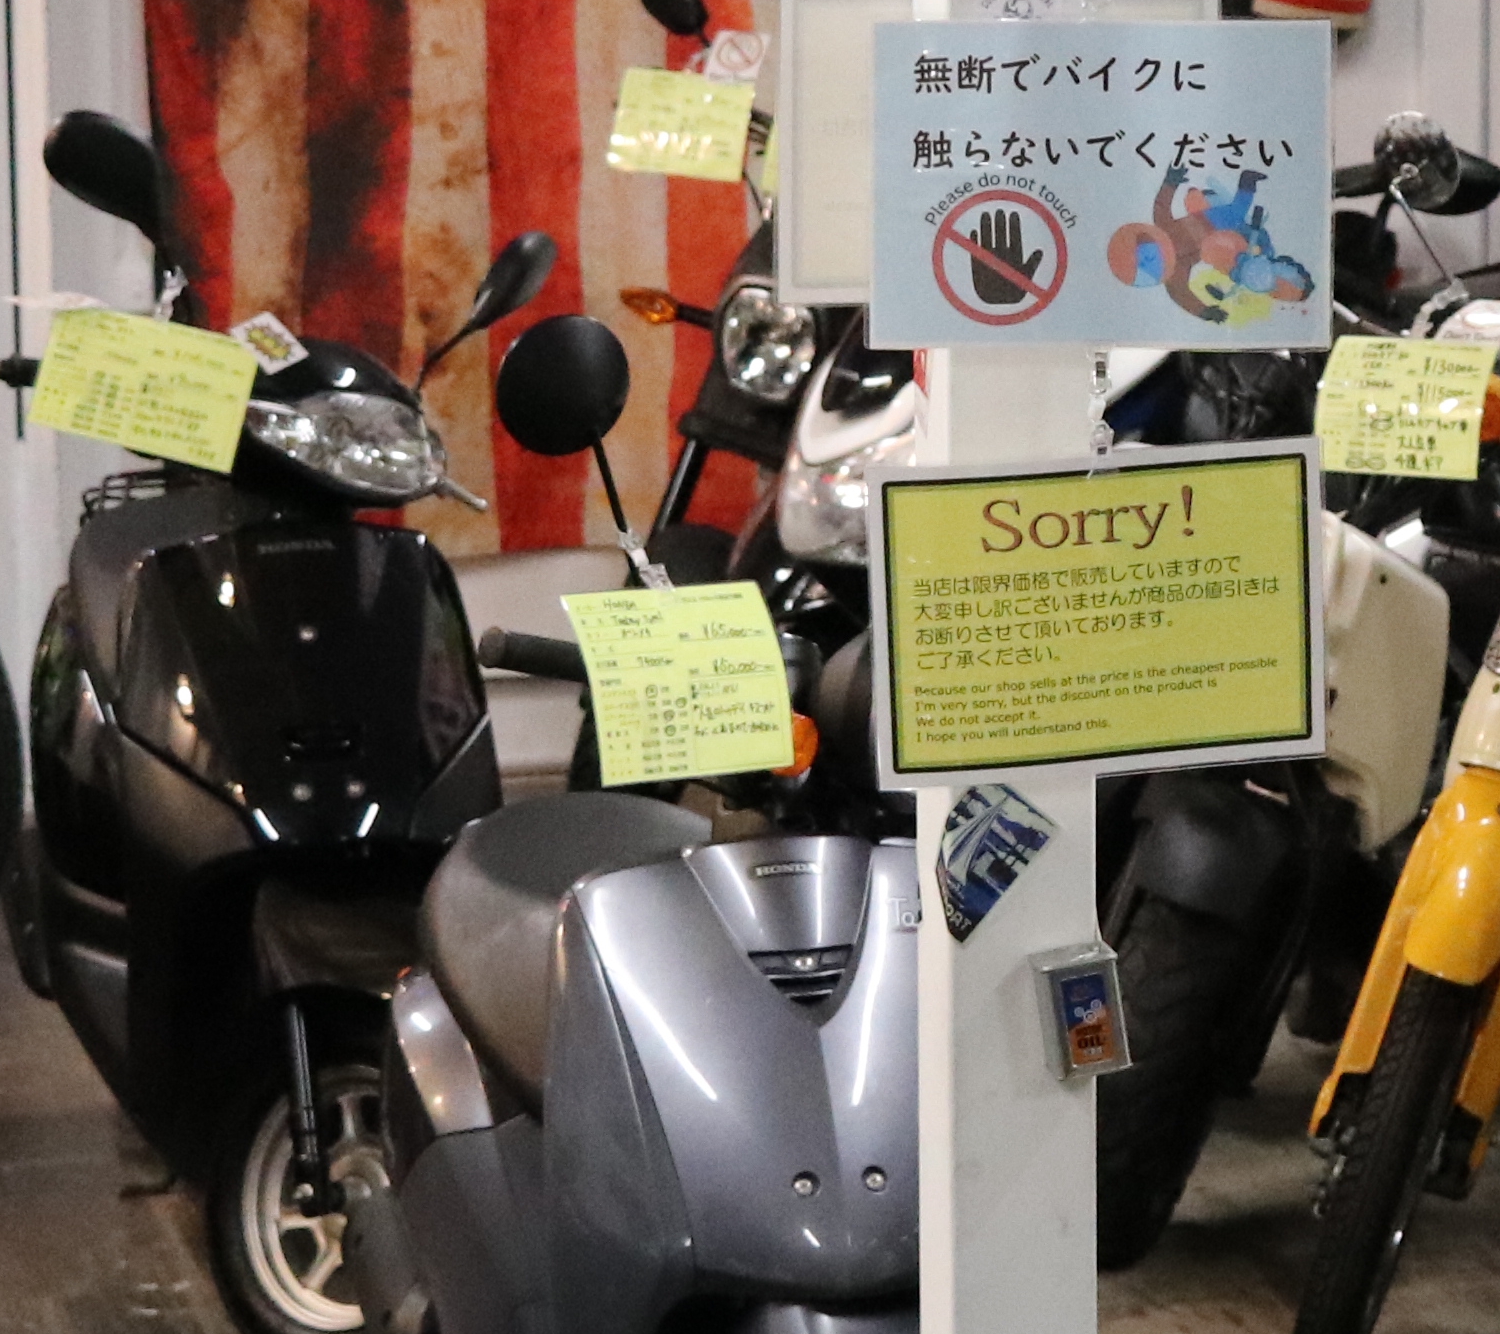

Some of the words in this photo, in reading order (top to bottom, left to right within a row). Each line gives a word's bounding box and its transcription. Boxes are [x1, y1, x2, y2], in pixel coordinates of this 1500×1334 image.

[913, 54, 1207, 95] 無断でバイクに
[911, 129, 1296, 170] 触らないでください
[924, 180, 974, 227] Please
[978, 172, 1001, 189] do
[1005, 174, 1037, 192] not
[1038, 184, 1079, 230] touch
[980, 484, 1195, 554] Sorry!
[912, 554, 1242, 599] 当店は限界価格で販売していますので
[913, 575, 1281, 623] 大変申し訳ございませんが商品の値引きは
[914, 608, 1175, 647] お断りさせて頂いております。
[914, 684, 967, 697] Because
[971, 683, 992, 694] our
[997, 680, 1026, 694] shop
[1030, 676, 1057, 689] sells
[1061, 675, 1073, 687] at
[1077, 673, 1096, 685] the
[1100, 671, 1130, 689] price
[1133, 668, 1143, 680] is
[1147, 667, 1167, 679] the
[1171, 661, 1225, 676] cheapest
[1229, 657, 1278, 674] possible
[916, 645, 1062, 670] ご了承ください。
[915, 700, 936, 712] I'm
[941, 700, 968, 713] very
[972, 697, 1008, 710] sorry,
[1012, 693, 1032, 706] but
[1036, 691, 1057, 704] the
[1060, 687, 1111, 702] discount
[1114, 686, 1131, 696] on
[1133, 682, 1153, 695] the
[1157, 678, 1204, 696] product
[1207, 676, 1218, 688] is
[916, 716, 935, 729] We
[939, 714, 955, 727] do
[959, 713, 979, 726] not
[984, 711, 1026, 726] accept
[1029, 709, 1041, 722] it.
[926, 731, 957, 745] hope
[961, 729, 984, 743] you
[988, 726, 1009, 738] will
[1013, 720, 1083, 738] understand
[1086, 717, 1111, 730] this.
[755, 862, 822, 878] HONDA
